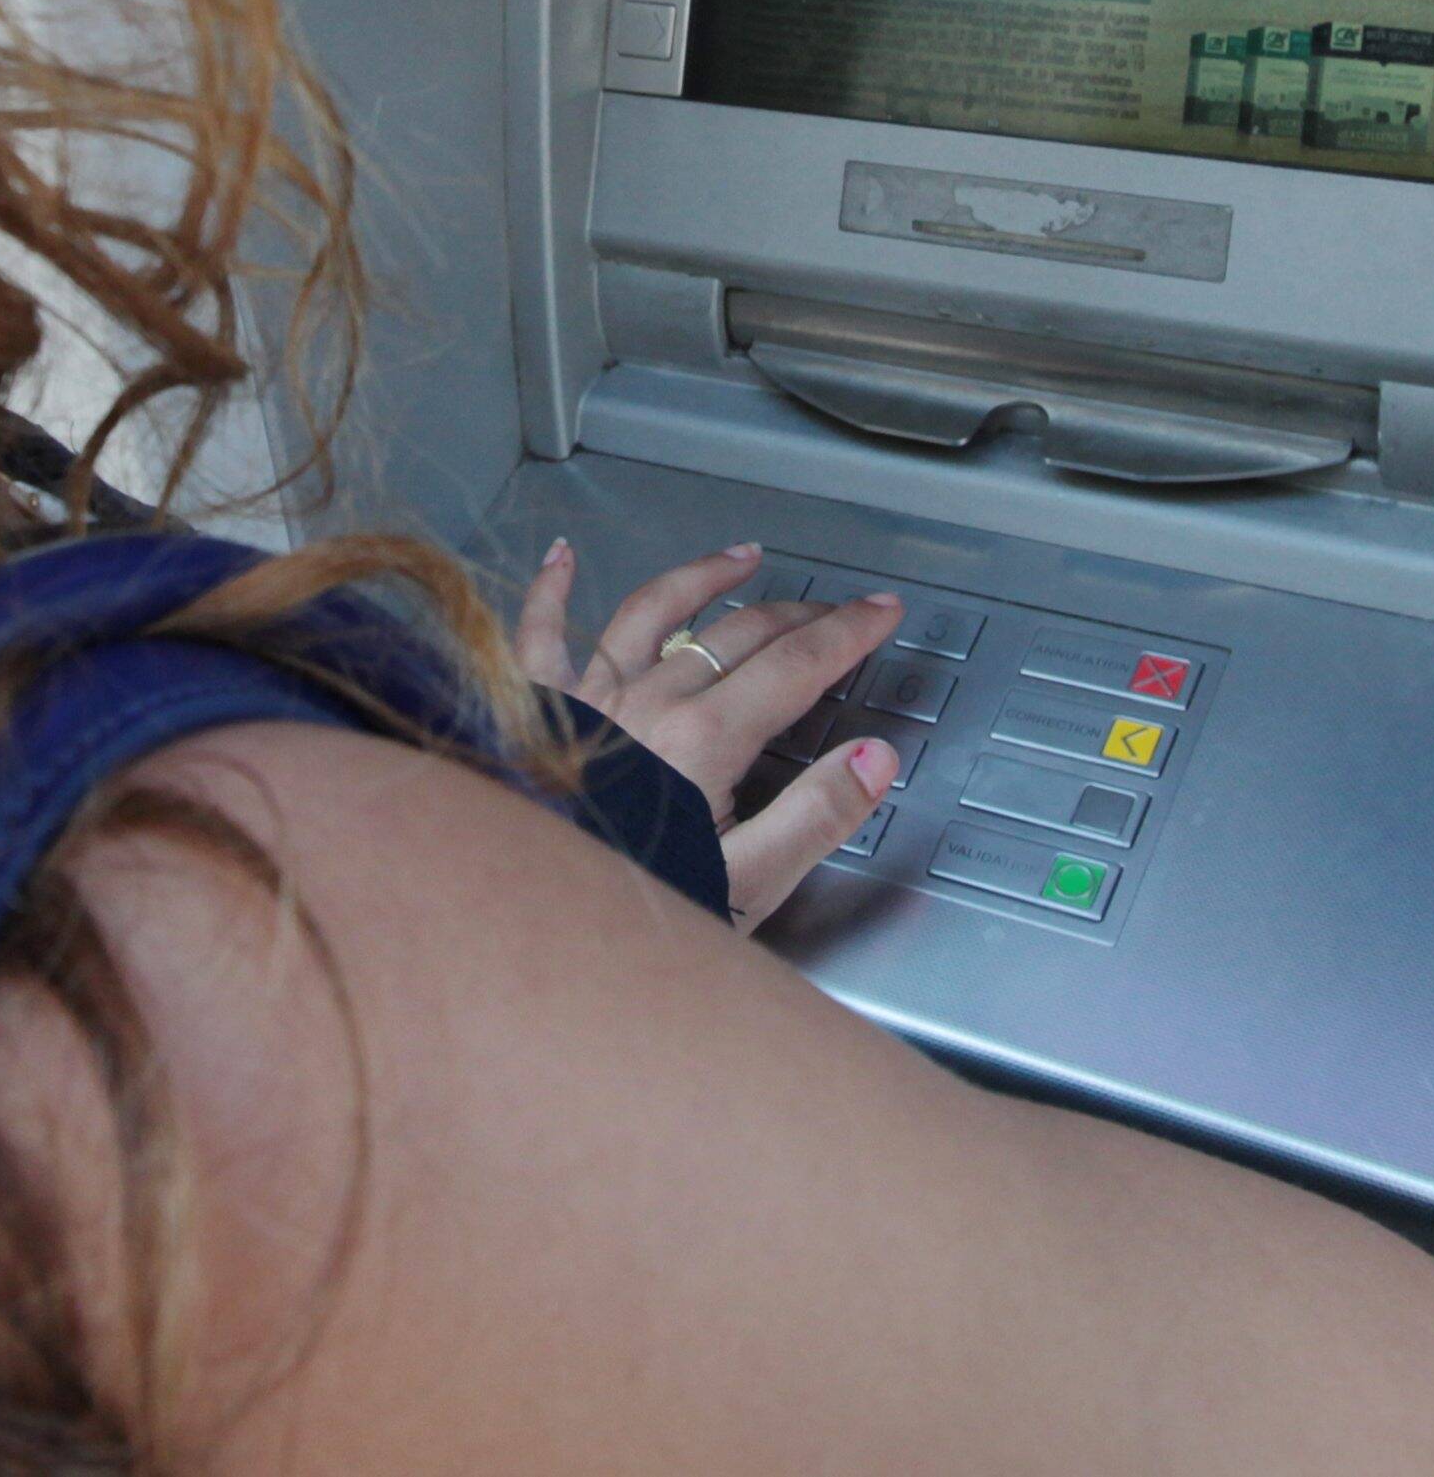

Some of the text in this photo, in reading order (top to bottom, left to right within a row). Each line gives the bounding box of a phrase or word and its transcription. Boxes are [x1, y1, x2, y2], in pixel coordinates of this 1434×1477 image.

[924, 612, 952, 642] 3
[1035, 645, 1130, 674] ANNULATION
[896, 674, 923, 704] 6
[1004, 708, 1102, 739] CORRECTION
